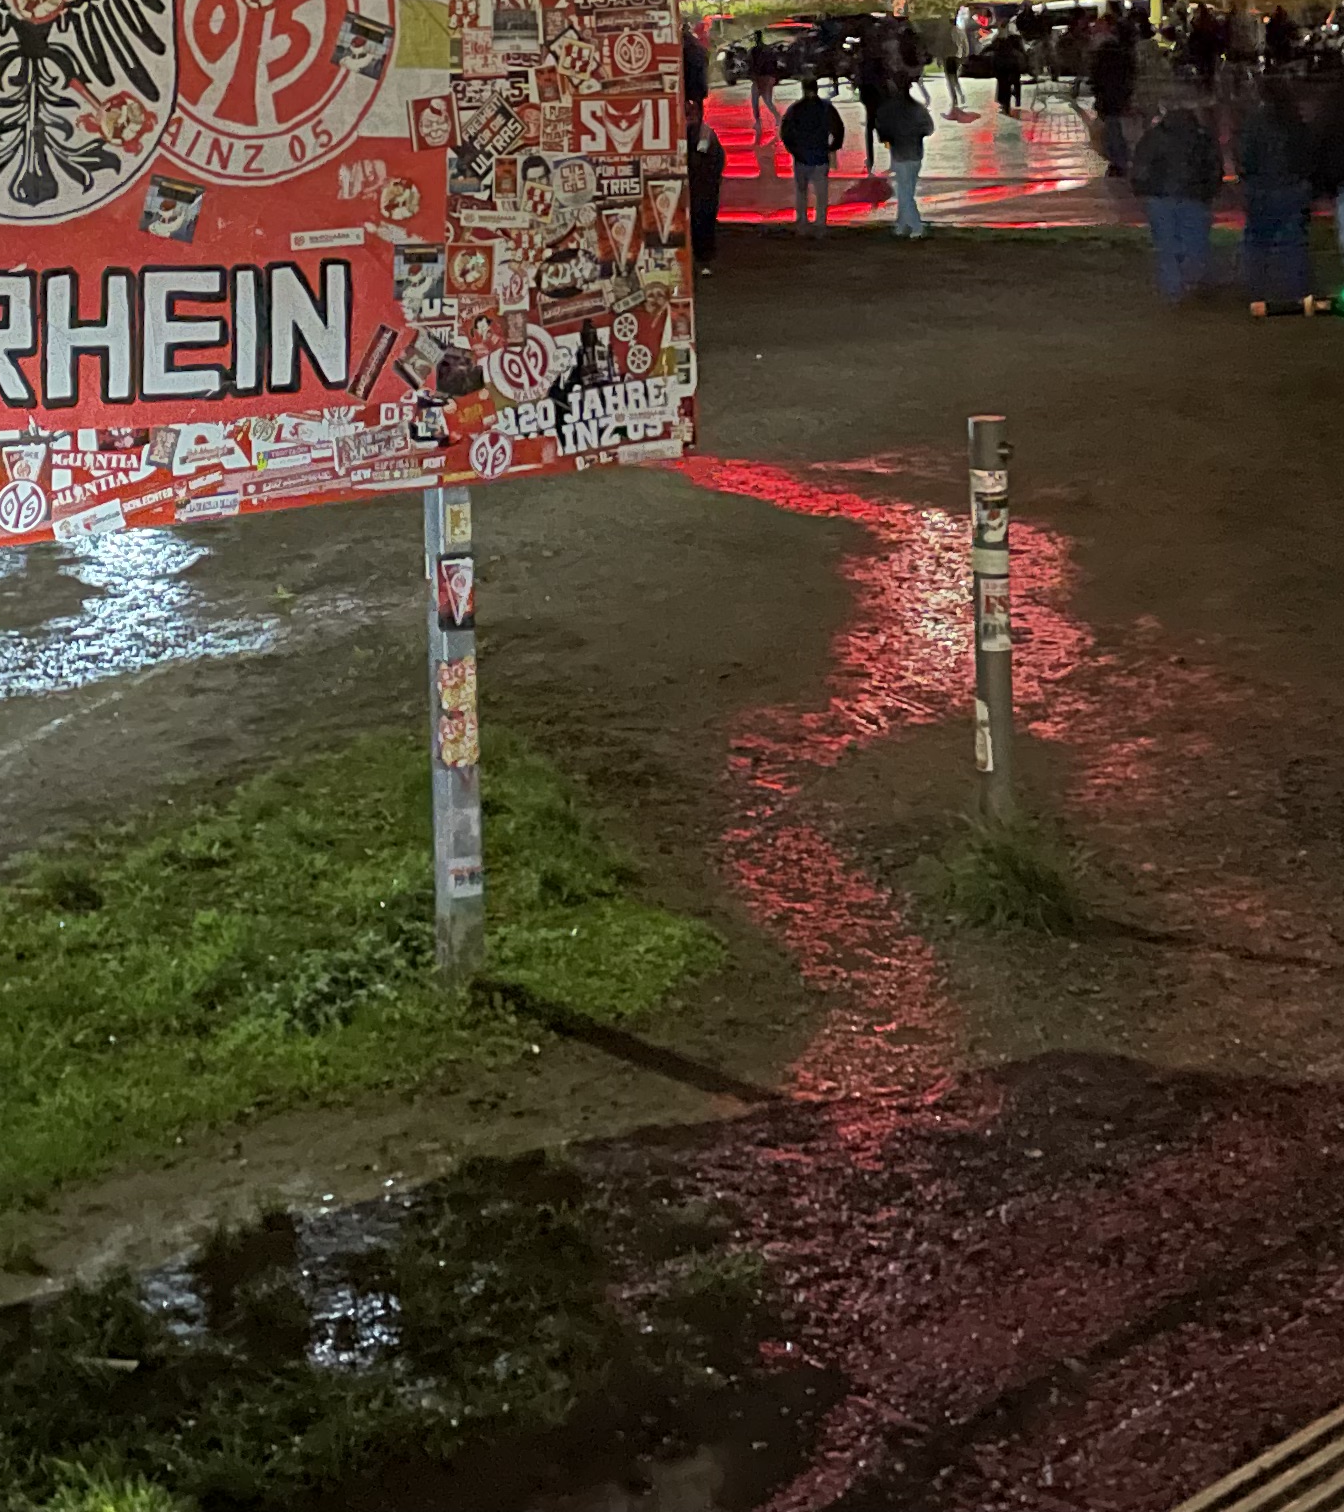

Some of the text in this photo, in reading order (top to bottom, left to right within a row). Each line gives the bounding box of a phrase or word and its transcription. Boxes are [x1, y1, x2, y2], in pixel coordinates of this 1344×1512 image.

[462, 95, 502, 142] FREIHEIT
[161, 115, 334, 174] AINZ 05
[471, 117, 524, 176] ULTRAS
[599, 177, 641, 196] TRAS
[563, 375, 670, 424] JAHRE
